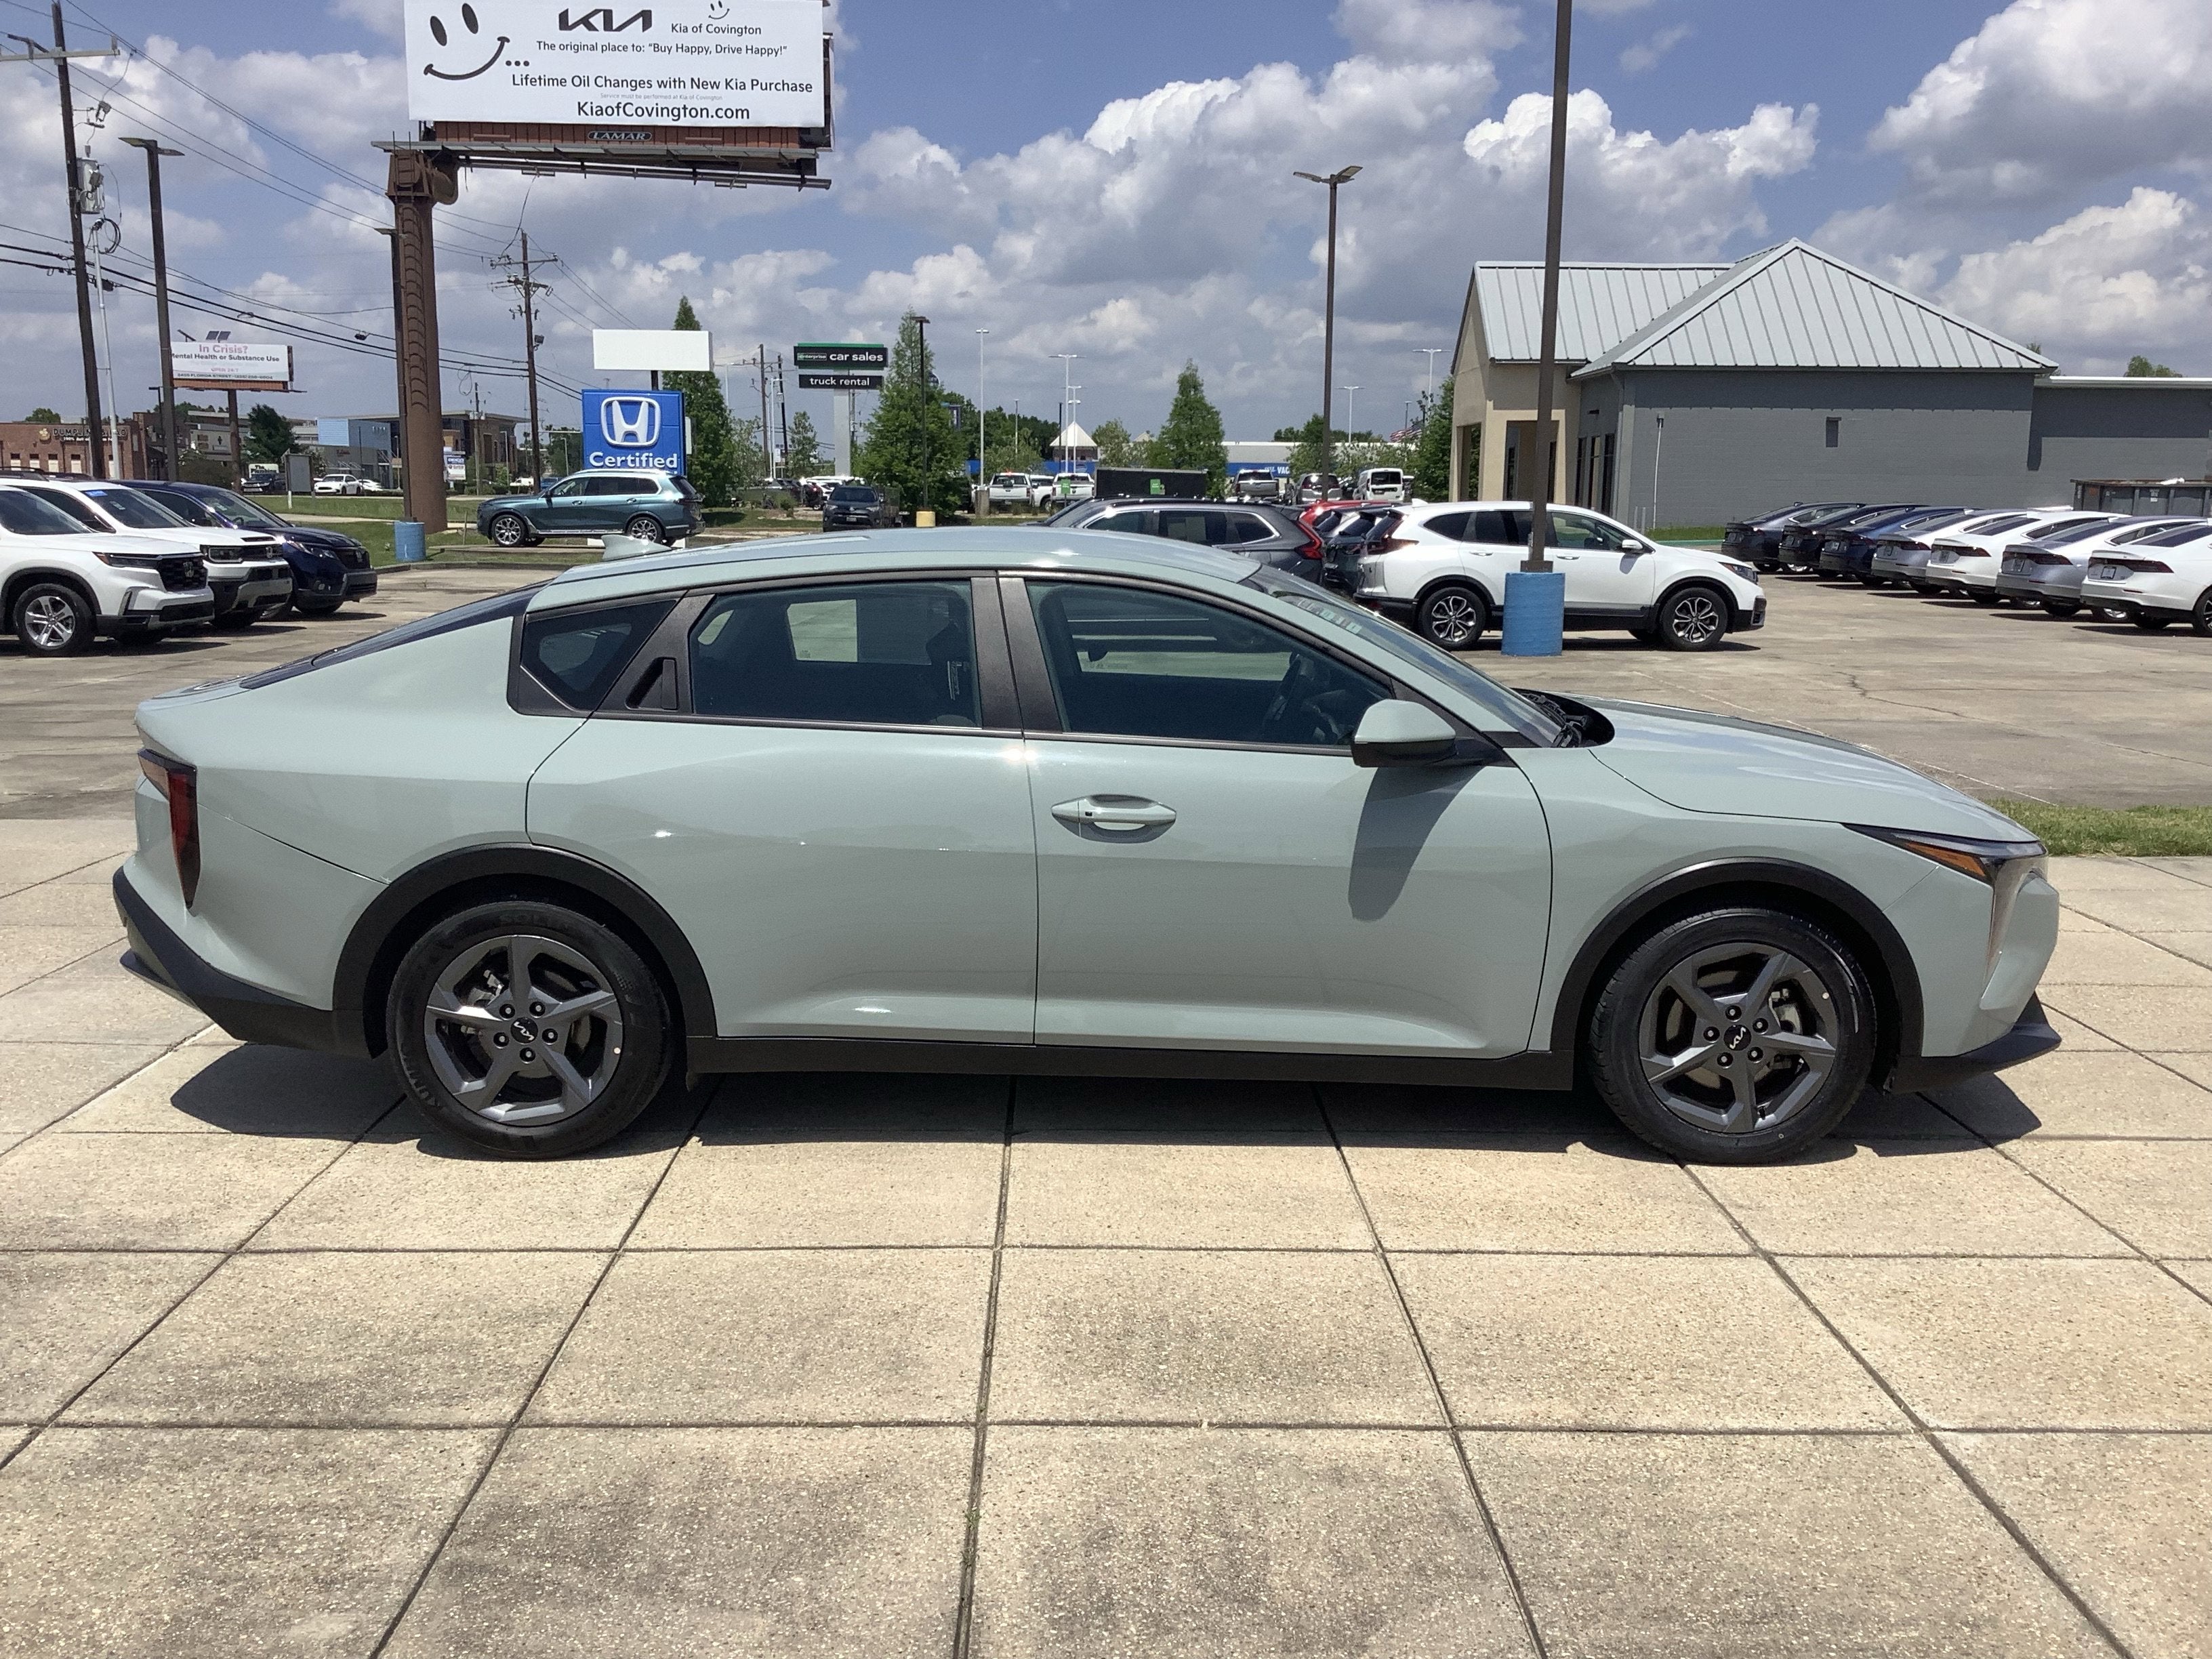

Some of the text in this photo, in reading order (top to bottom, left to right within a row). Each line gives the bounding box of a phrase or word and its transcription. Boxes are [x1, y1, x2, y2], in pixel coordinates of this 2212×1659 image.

[672, 23, 762, 37] Kia of Covington
[537, 41, 556, 50] The
[559, 41, 598, 53] original
[601, 42, 628, 54] place
[632, 43, 645, 52] to:
[676, 43, 712, 56] Happy,
[716, 44, 742, 54] Drive
[512, 74, 813, 92] Lifetime Oil Changes with New Kia Purchase
[577, 102, 750, 121] KiaofCovington.com
[199, 344, 248, 354] In Crisis?
[830, 353, 849, 361] car
[852, 352, 884, 361] sales
[810, 377, 869, 386] truck rental
[589, 451, 678, 468] Certified
